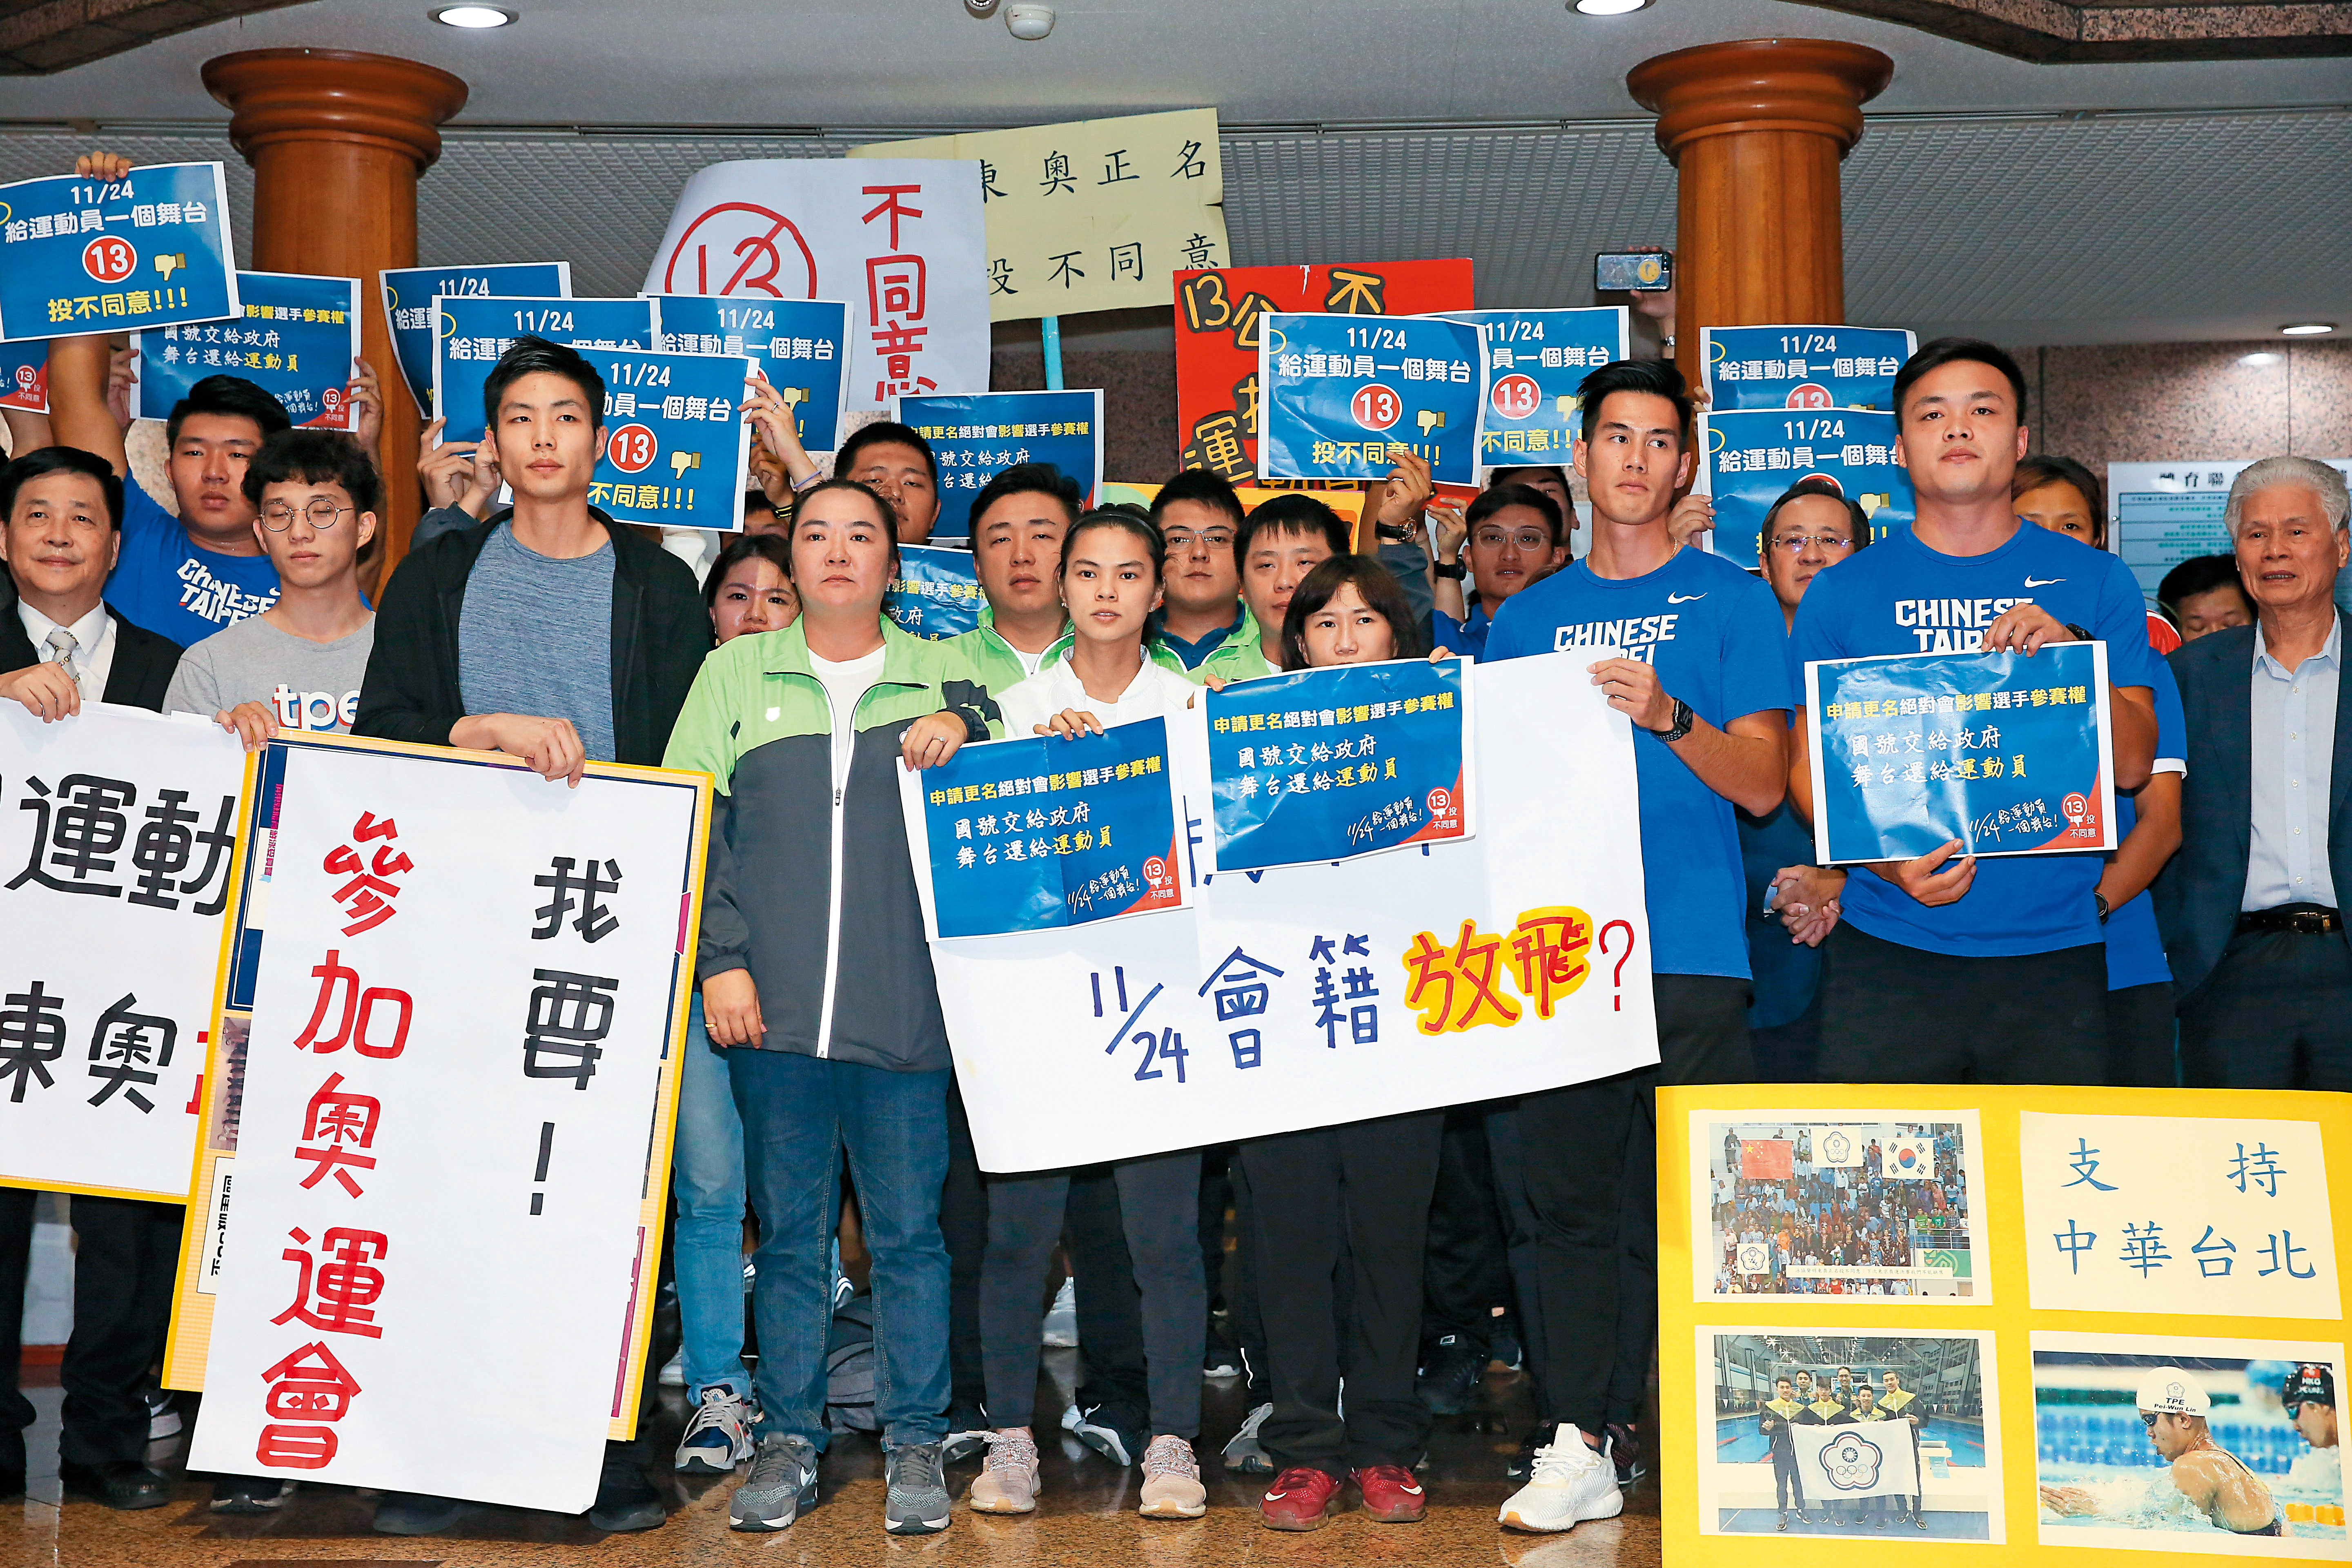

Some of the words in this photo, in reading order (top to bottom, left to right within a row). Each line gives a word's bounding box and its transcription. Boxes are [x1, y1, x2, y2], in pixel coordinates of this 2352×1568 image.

[71, 180, 134, 204] 11/24
[5, 201, 207, 243] 給運動員一個舞台
[91, 244, 129, 275] 13
[439, 277, 490, 296] 11/24
[862, 184, 938, 402] 不同意
[48, 287, 187, 322] 投不同意!!!
[717, 307, 775, 329] 11/24
[514, 309, 574, 332] 11/24
[1486, 320, 1544, 342] 11/24
[165, 325, 280, 348] 國號交給政府
[661, 332, 834, 360] 給運動員一個舞台
[1347, 327, 1407, 350] 11/24
[1780, 334, 1837, 354] 11/24
[163, 345, 298, 372] 舞台還給運動員
[1278, 353, 1471, 384] 給運動員一個舞台
[1719, 357, 1899, 381] 給運動員一個舞台
[20, 371, 33, 382] 13
[611, 363, 670, 387] 11/24
[326, 394, 337, 403] 13
[1359, 392, 1396, 423] 13
[1499, 382, 1533, 411] 13
[1784, 419, 1845, 440] 11/24
[616, 431, 650, 463] 13
[931, 448, 1031, 467] 號交給政府
[587, 481, 694, 510] 不同意!!!
[177, 558, 276, 613] CHINESE
[886, 579, 987, 600] 影響選手參賽
[180, 583, 256, 627] TAIPE
[1895, 598, 2034, 628] CHINES
[1554, 615, 1678, 652] CHINESE
[1913, 629, 1989, 653] TAIP
[272, 684, 360, 731] tpe
[1214, 692, 1454, 734] 申請更名絕對會影響選手參賽權
[1826, 686, 2086, 720] 申請更名絕對會影響選手參賽權
[1238, 734, 1376, 769] 國號交給政府
[1850, 725, 2001, 757] 國號交給政府
[930, 755, 1162, 806] 申請更名絕對會影響選手參賽權
[1238, 757, 1397, 799] 舞台還給運動員
[1850, 754, 2027, 788] 舞台還給運動員
[1372, 796, 1413, 826] 給運動員
[1431, 795, 1446, 806] 13
[1449, 807, 1457, 816] 投
[1998, 798, 2046, 824] 給運動員
[2067, 800, 2083, 814] 13
[954, 801, 1091, 840] 國號交給政府
[1347, 815, 1373, 845] 11/24
[1433, 819, 1457, 829] 不同意
[1969, 812, 2000, 843] 11/24
[2070, 827, 2097, 838] 不同意
[2086, 814, 2095, 824] 投
[956, 826, 1112, 869] 舞台還給運動員
[1089, 865, 1130, 895] 給運動員
[1147, 864, 1162, 875] 13
[1165, 875, 1173, 886] 投
[1067, 883, 1094, 914] 11/24
[1150, 889, 1174, 900] 不同意
[0, 981, 209, 1115] 東奧
[523, 856, 624, 1216] 我要!
[257, 811, 414, 1469] 參加奧運會
[2060, 1138, 2287, 1197] 支持
[2053, 1219, 2316, 1279] 中華台北
